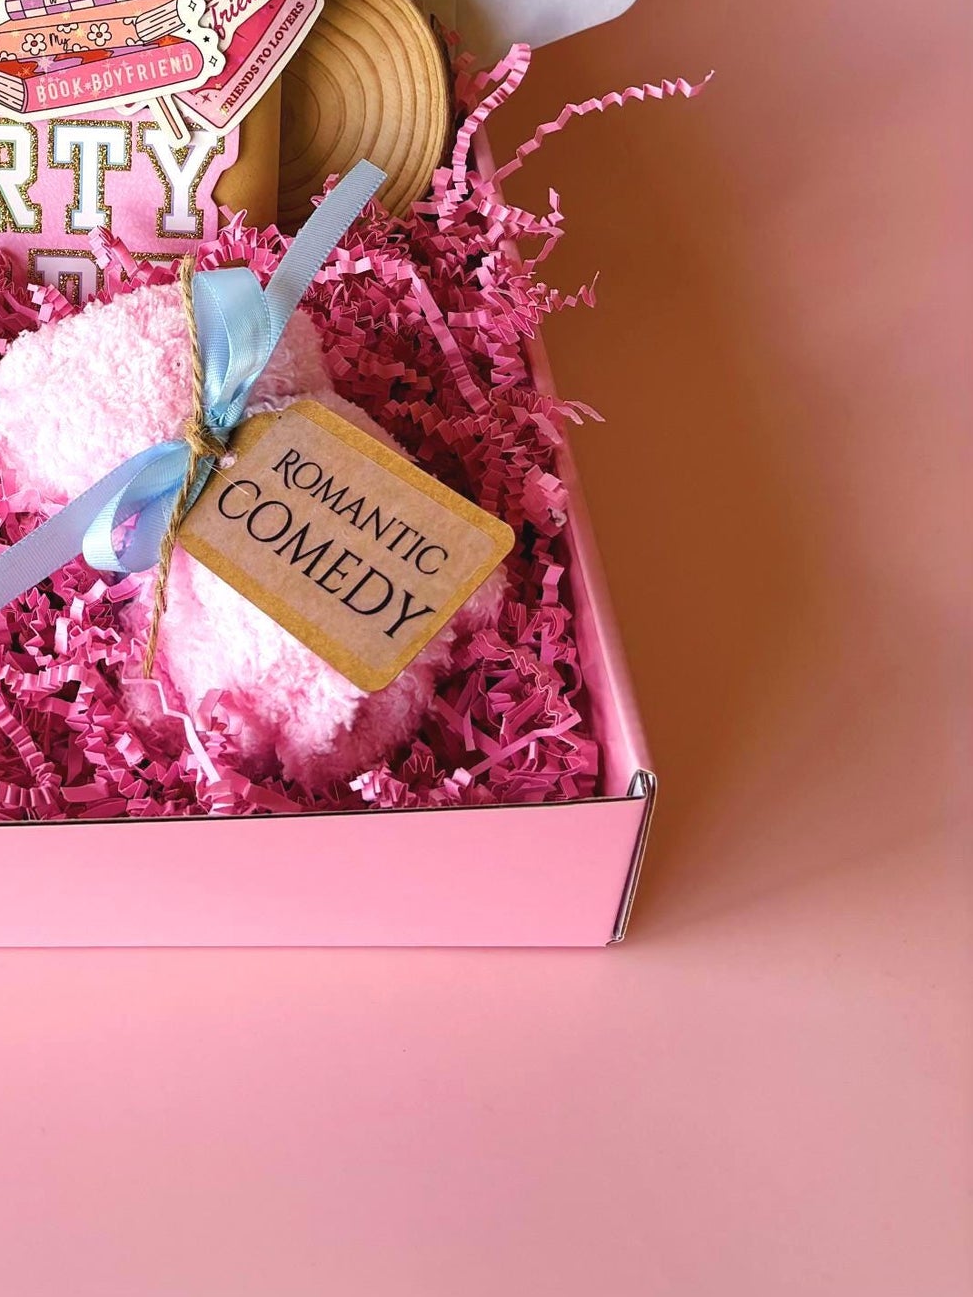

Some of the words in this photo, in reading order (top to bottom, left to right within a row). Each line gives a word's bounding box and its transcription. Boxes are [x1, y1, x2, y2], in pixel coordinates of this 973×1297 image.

[35, 79, 85, 104] BOOK
[90, 53, 195, 93] BOYFRIEND
[49, 32, 70, 51] My
[220, 63, 260, 115] FRIENDS
[256, 47, 272, 66] TO
[268, 1, 306, 49] LOVERS
[217, 479, 437, 639] COMEDY
[271, 447, 449, 576] ROMANTIC
